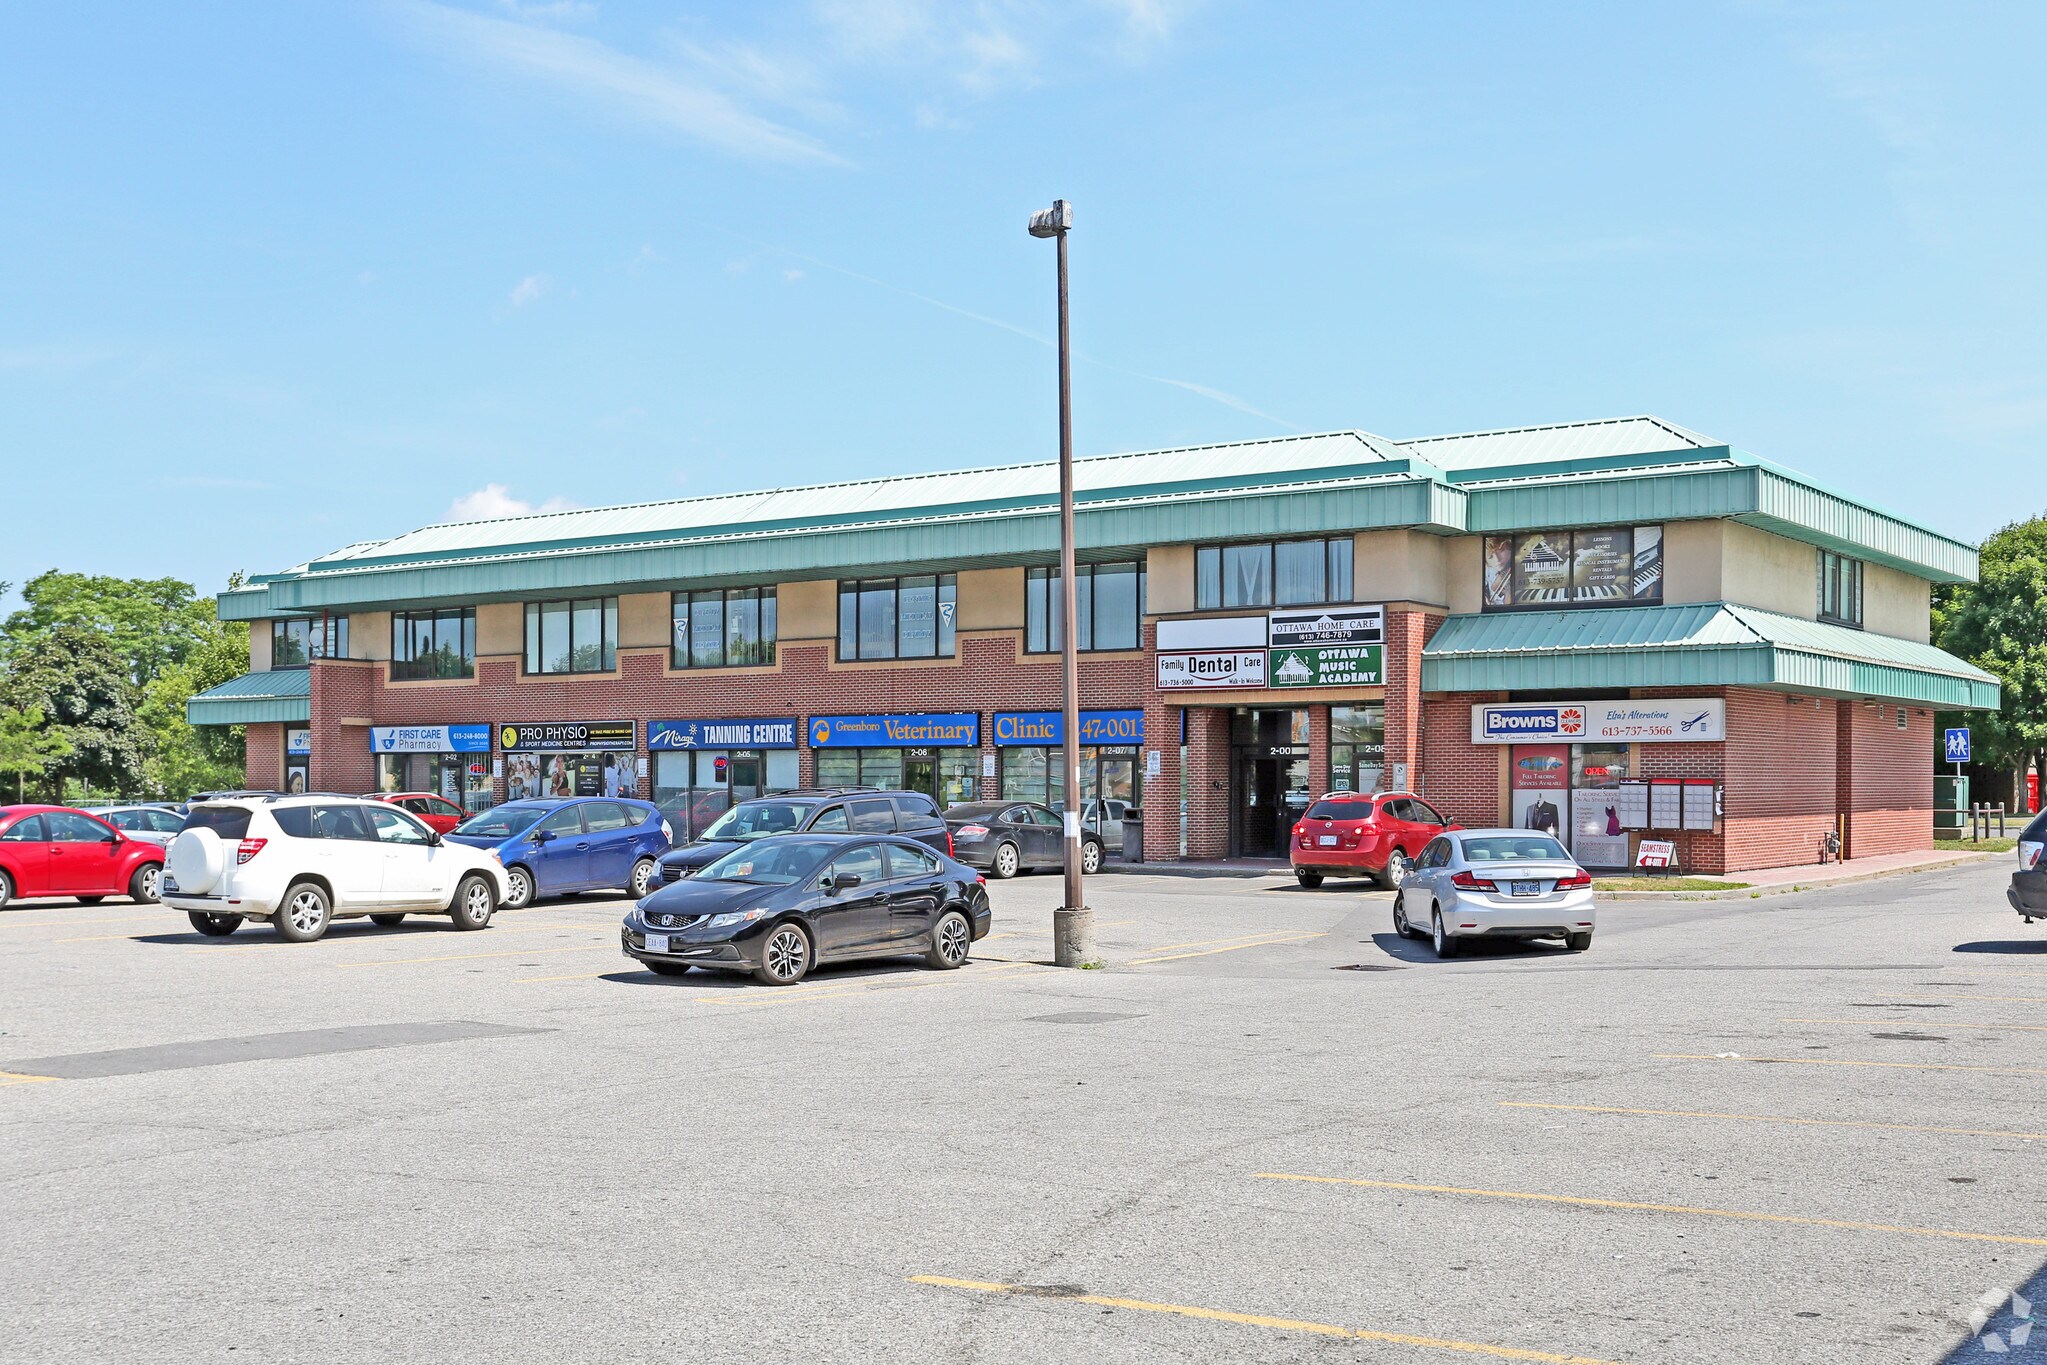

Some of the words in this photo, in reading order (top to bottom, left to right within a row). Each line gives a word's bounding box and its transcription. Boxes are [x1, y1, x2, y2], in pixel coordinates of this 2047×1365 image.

[1276, 624, 1313, 633] OTTAWA
[1318, 622, 1344, 630] HOME
[1350, 620, 1374, 628] CARE
[1316, 631, 1352, 639] 746-7879
[1318, 648, 1368, 660] OTTAWA
[1161, 660, 1184, 671] Family
[1189, 655, 1237, 673] Dental
[1244, 657, 1261, 667] Care
[1319, 661, 1357, 673] MUSIC
[1318, 672, 1377, 683] ACADEMY
[1489, 713, 1556, 728] Browns
[1606, 710, 1626, 720] Elsa's
[1628, 710, 1669, 719] Alterations
[520, 727, 542, 739] PRO
[546, 726, 587, 739] PHYSIO
[836, 721, 880, 732] Greenboro
[884, 720, 975, 742] Veterinary
[997, 717, 1054, 738] Clinic
[1602, 726, 1672, 736] 613-737-5566
[400, 730, 419, 739] FIRST
[421, 729, 441, 739] CARE
[650, 729, 698, 747] Mirage
[704, 725, 750, 744] TANNING
[753, 724, 794, 744] CENTRE
[399, 739, 441, 751] Pharmacy
[1108, 747, 1125, 755] 2-07
[1270, 747, 1291, 755] 2-00
[1584, 767, 1610, 776] OPEN
[1641, 843, 1670, 853] SEAMSTRESS
